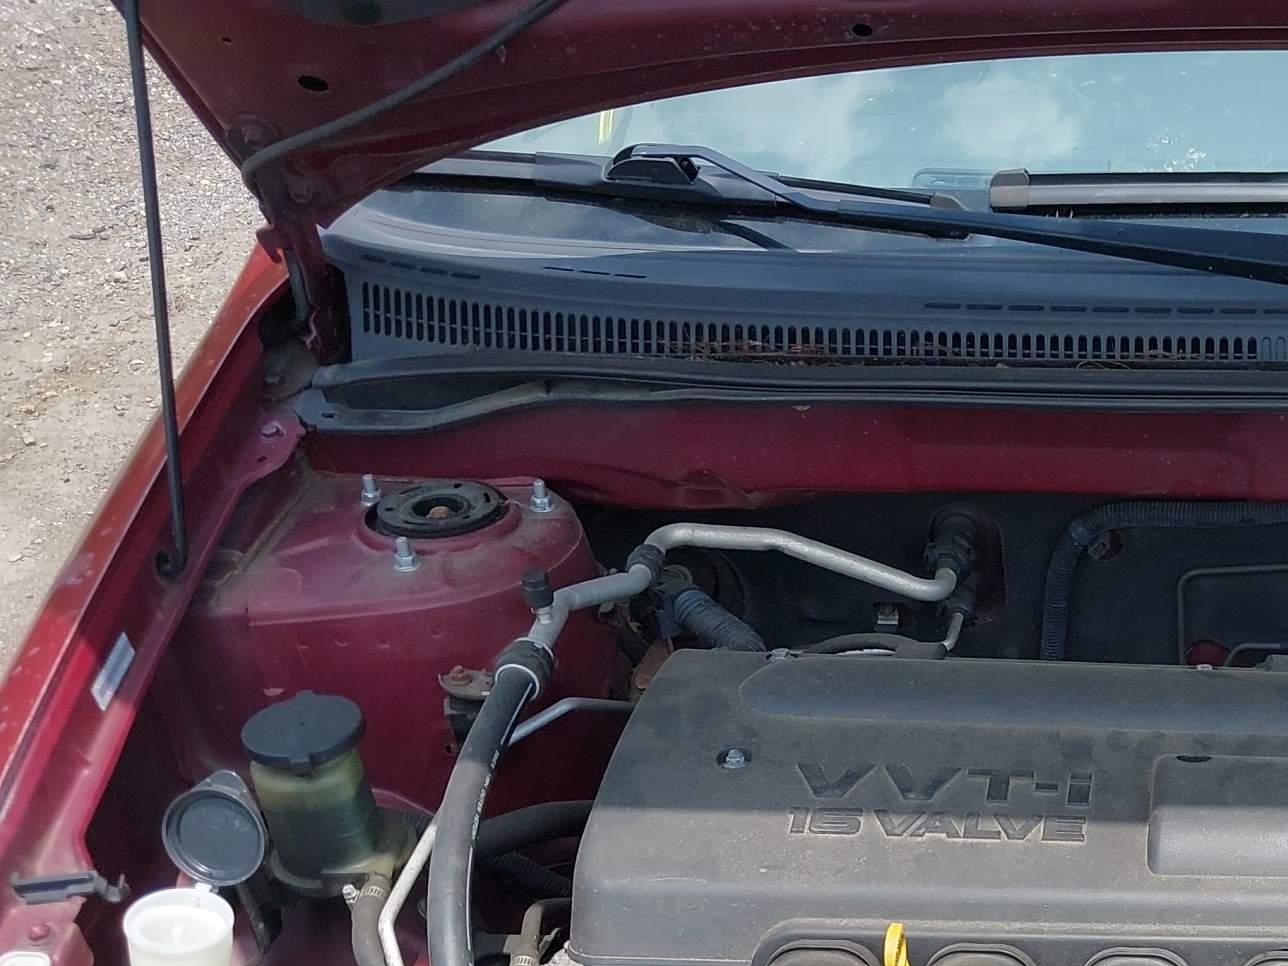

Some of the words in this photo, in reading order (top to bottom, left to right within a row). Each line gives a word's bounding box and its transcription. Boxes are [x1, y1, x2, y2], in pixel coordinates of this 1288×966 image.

[795, 762, 1093, 807] VVT-i
[787, 806, 864, 836] 16
[873, 808, 1088, 844] VALVE
